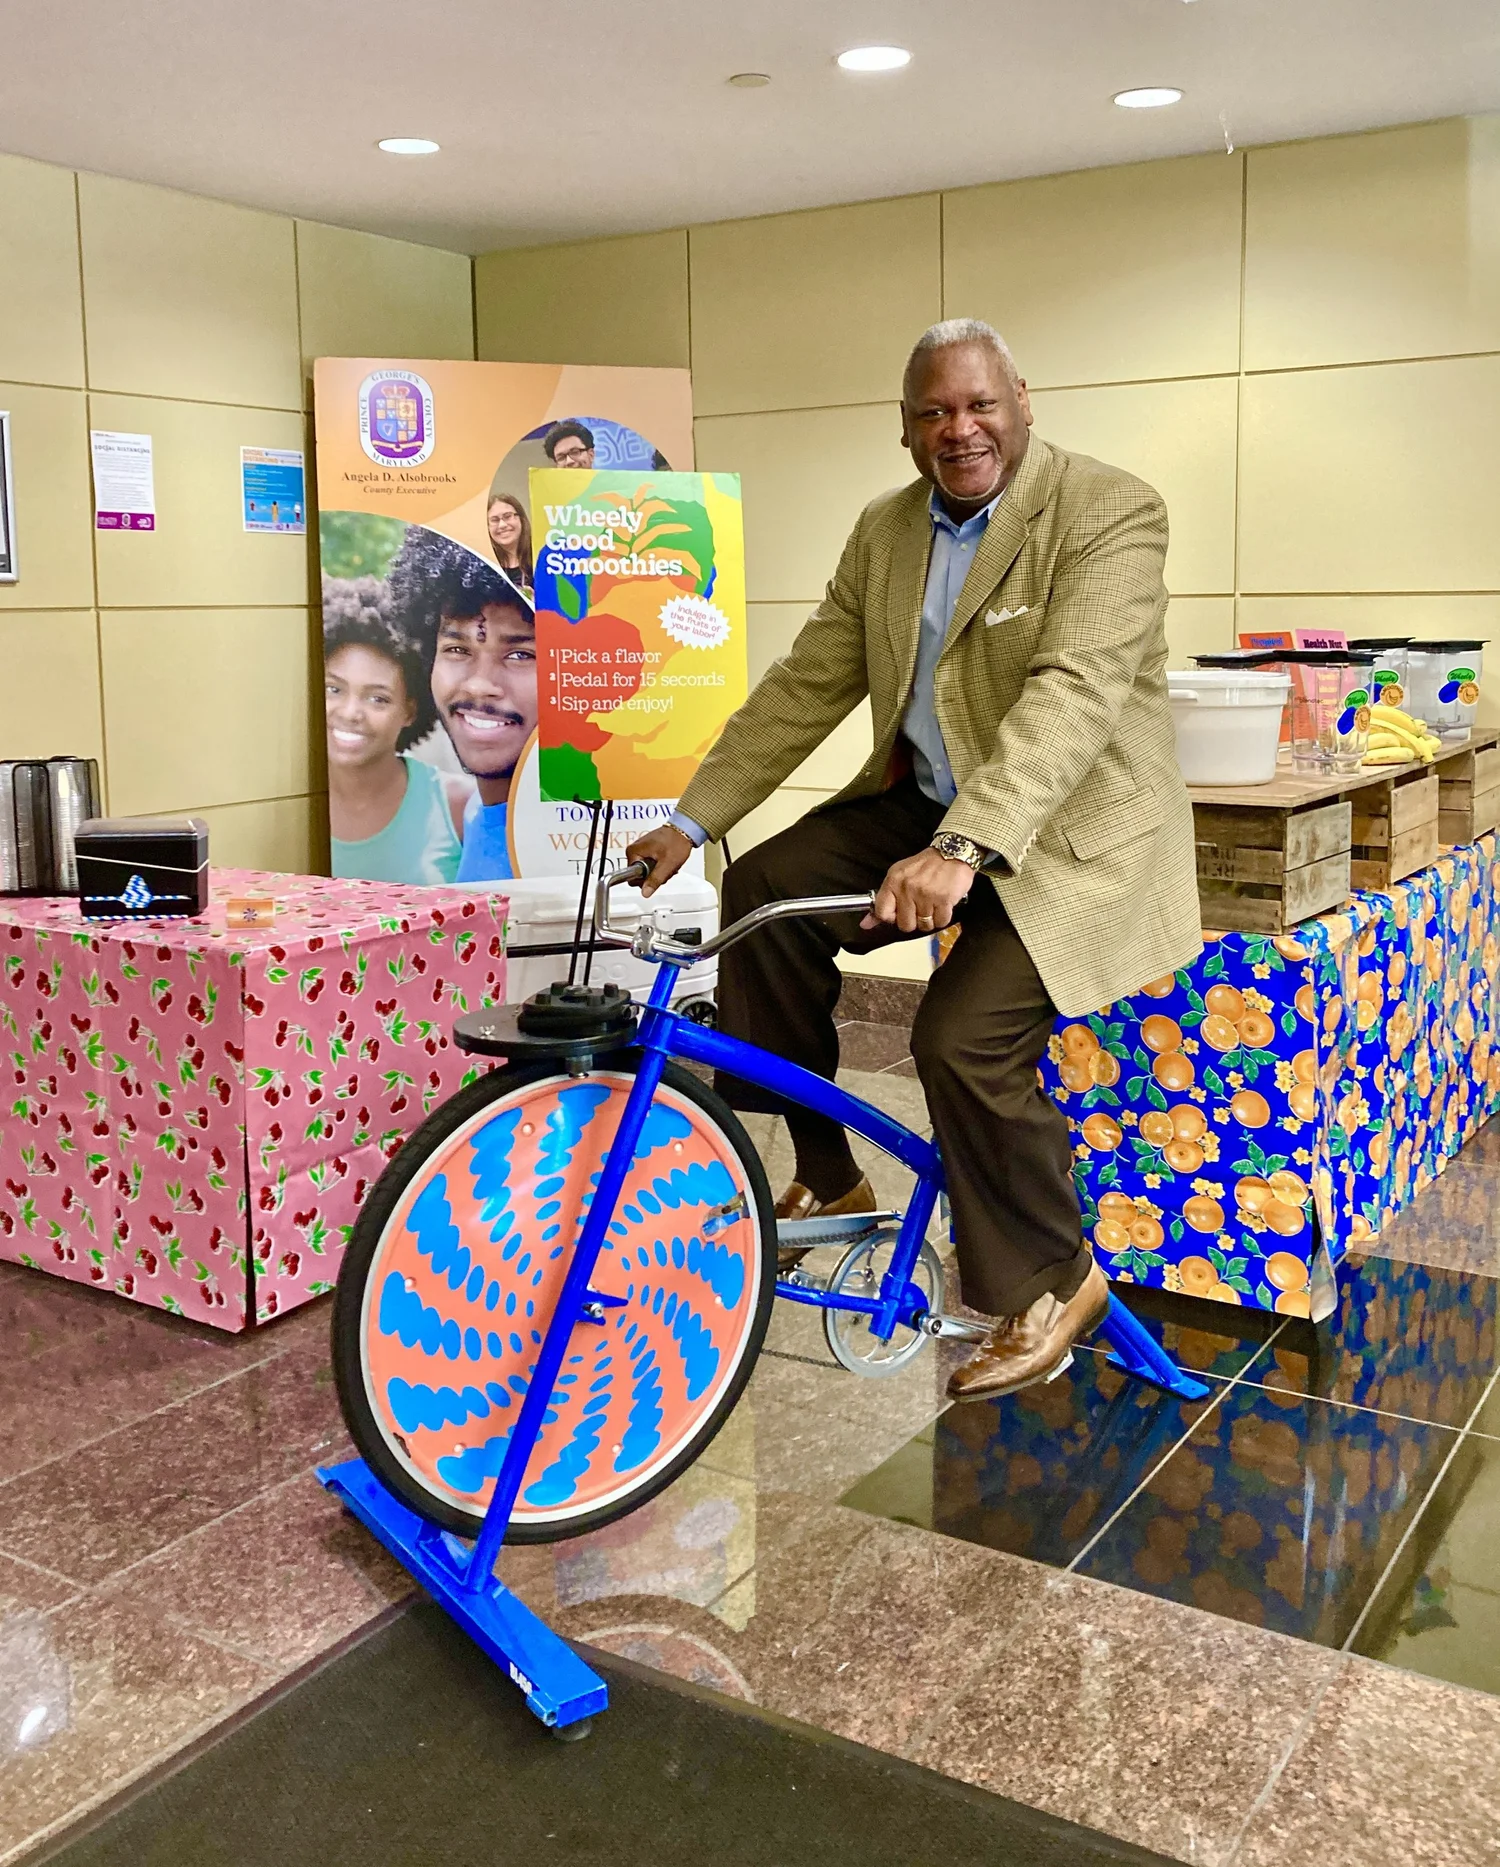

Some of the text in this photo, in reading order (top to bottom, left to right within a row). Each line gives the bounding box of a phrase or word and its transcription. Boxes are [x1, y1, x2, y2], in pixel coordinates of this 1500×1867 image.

[360, 396, 369, 434] PRINCE
[424, 397, 433, 439] COUNTY
[371, 451, 426, 467] MARYLAND
[341, 471, 457, 483] Angela D. Alsobrooks
[363, 485, 437, 496] County Executive
[543, 503, 643, 534] Wheely
[545, 528, 616, 552] Good
[546, 552, 683, 577] Smoothies
[670, 611, 722, 633] the fruits of
[677, 604, 717, 623] Indulge in
[671, 621, 716, 640] your labor!
[1303, 638, 1343, 649] Health Nut
[550, 649, 662, 664] 1 Pick a flavor
[550, 672, 726, 688] 2 Pedal for 15 seconds
[550, 696, 674, 714] 3 Sip and enjoy!
